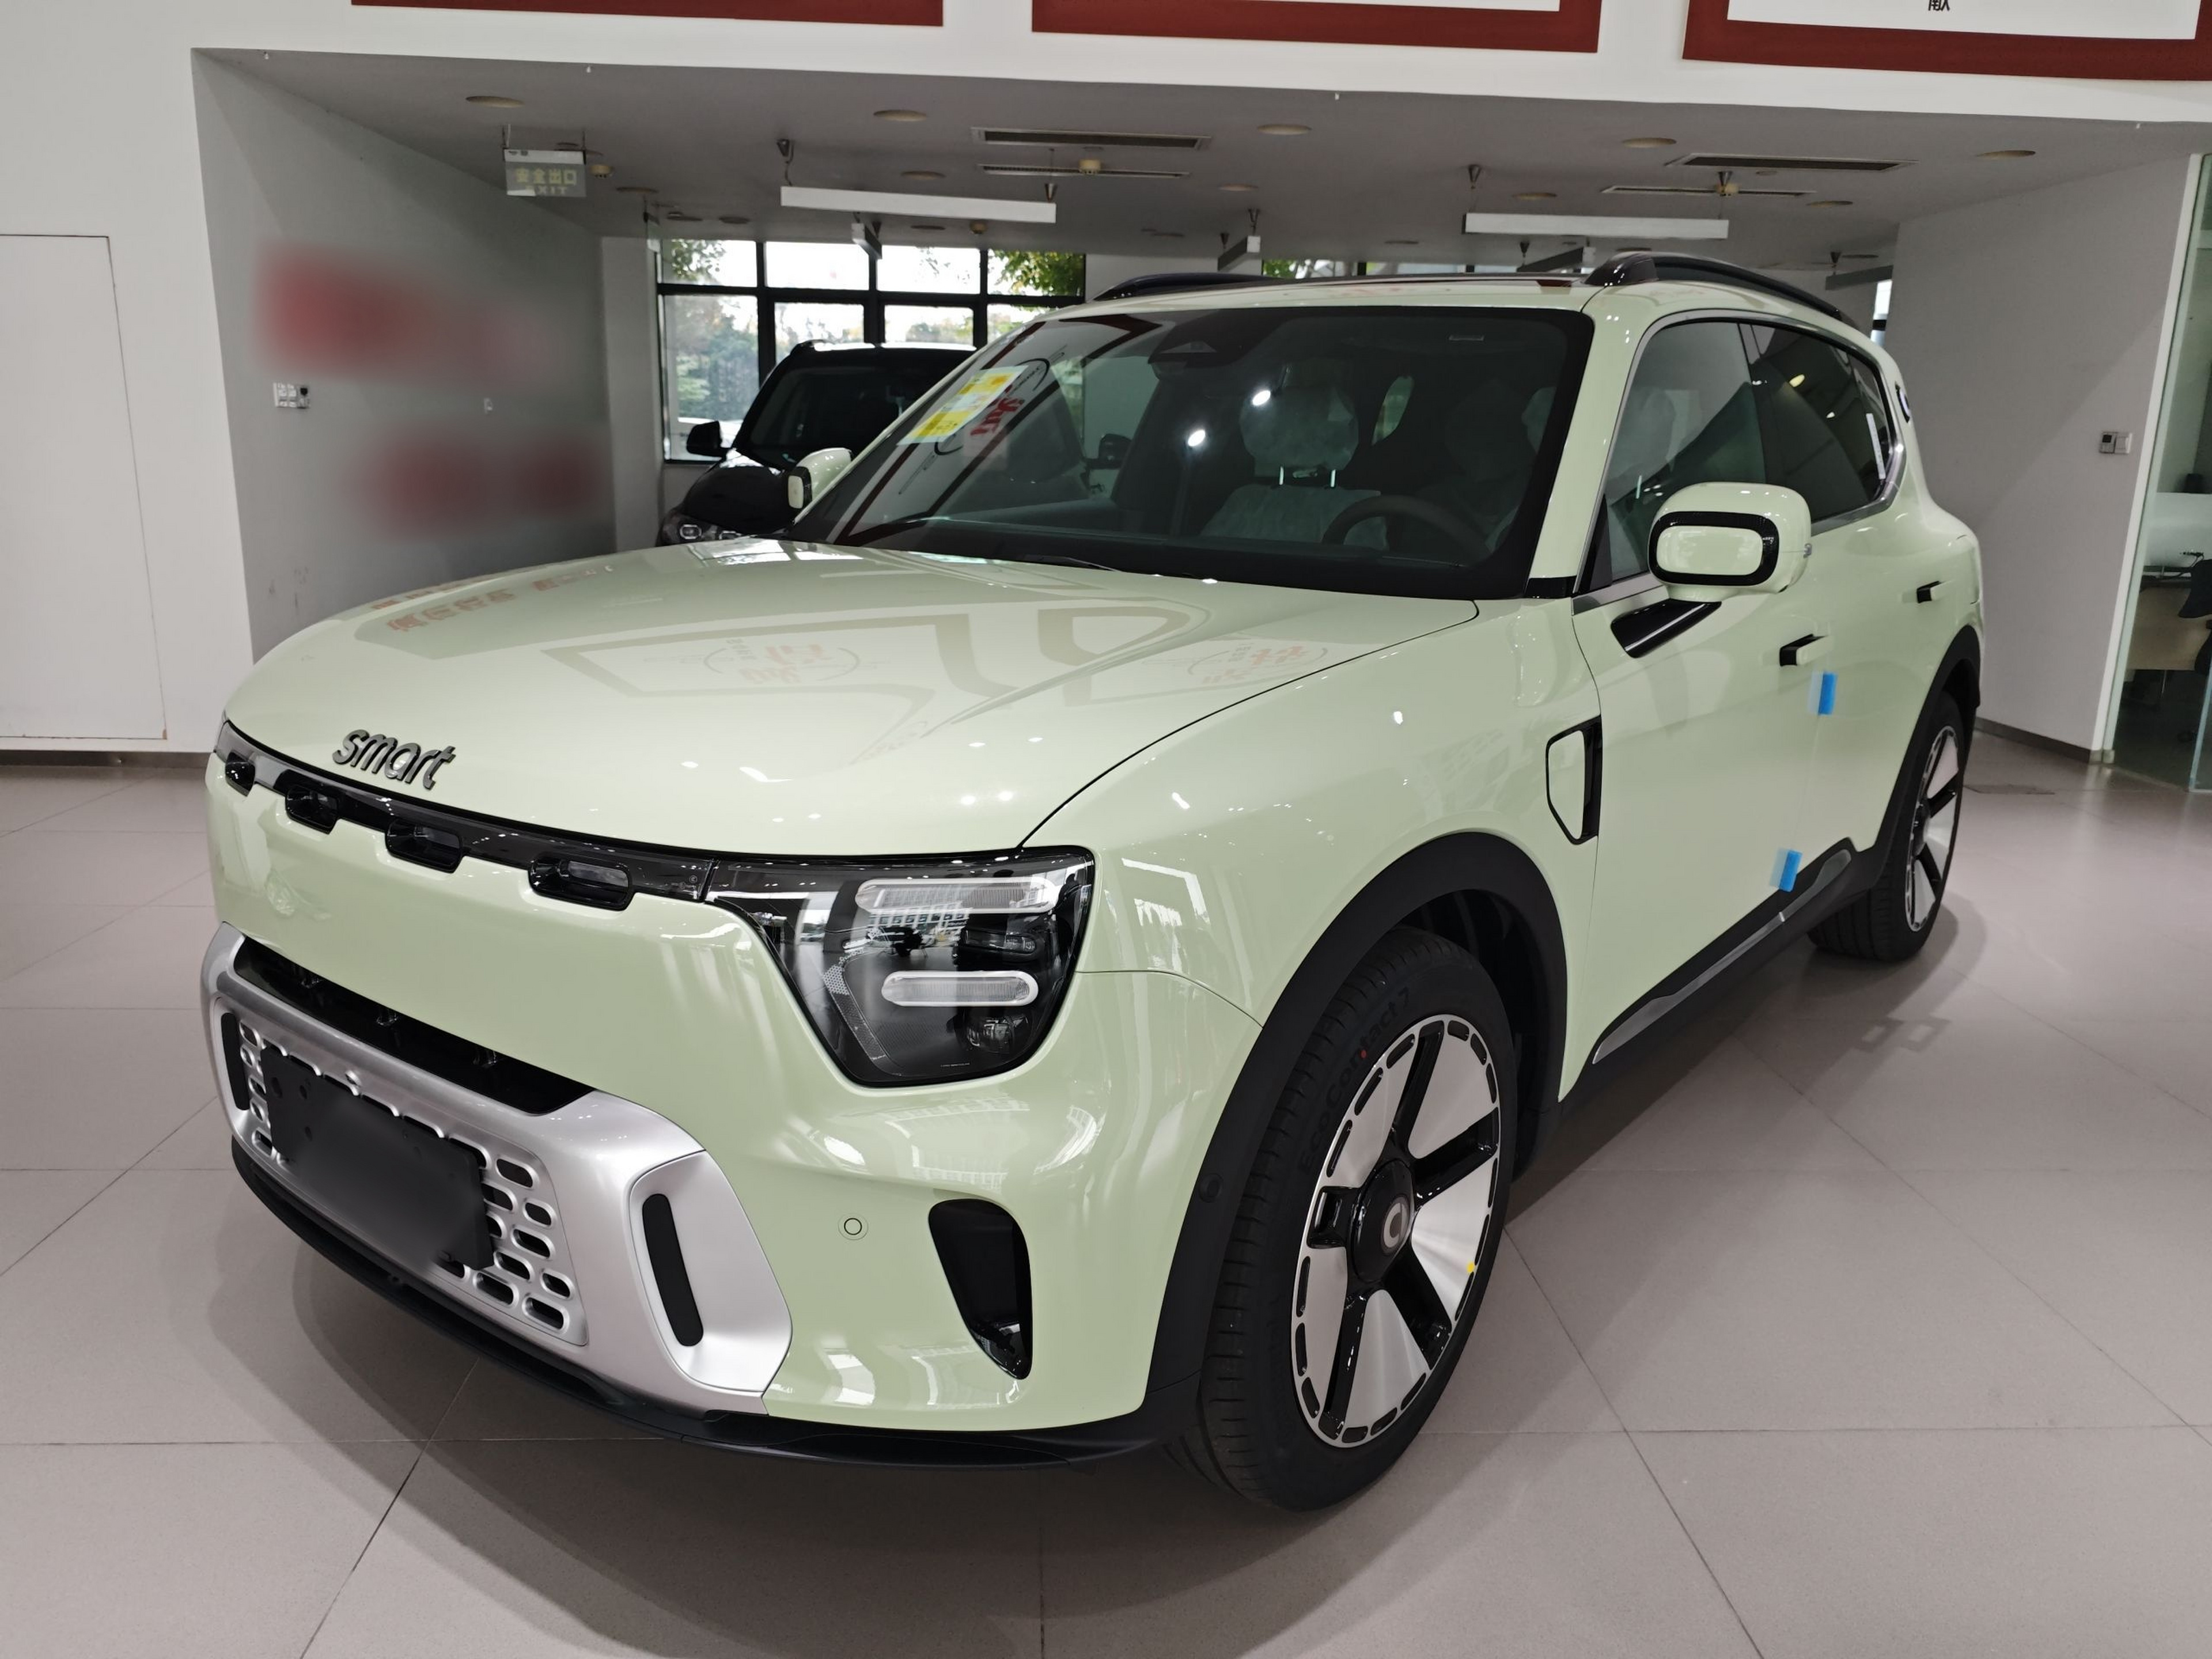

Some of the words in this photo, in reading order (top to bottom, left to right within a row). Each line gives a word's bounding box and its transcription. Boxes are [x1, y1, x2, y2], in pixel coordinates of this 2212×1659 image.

[516, 167, 576, 185] 安全出口
[332, 729, 456, 790] smart
